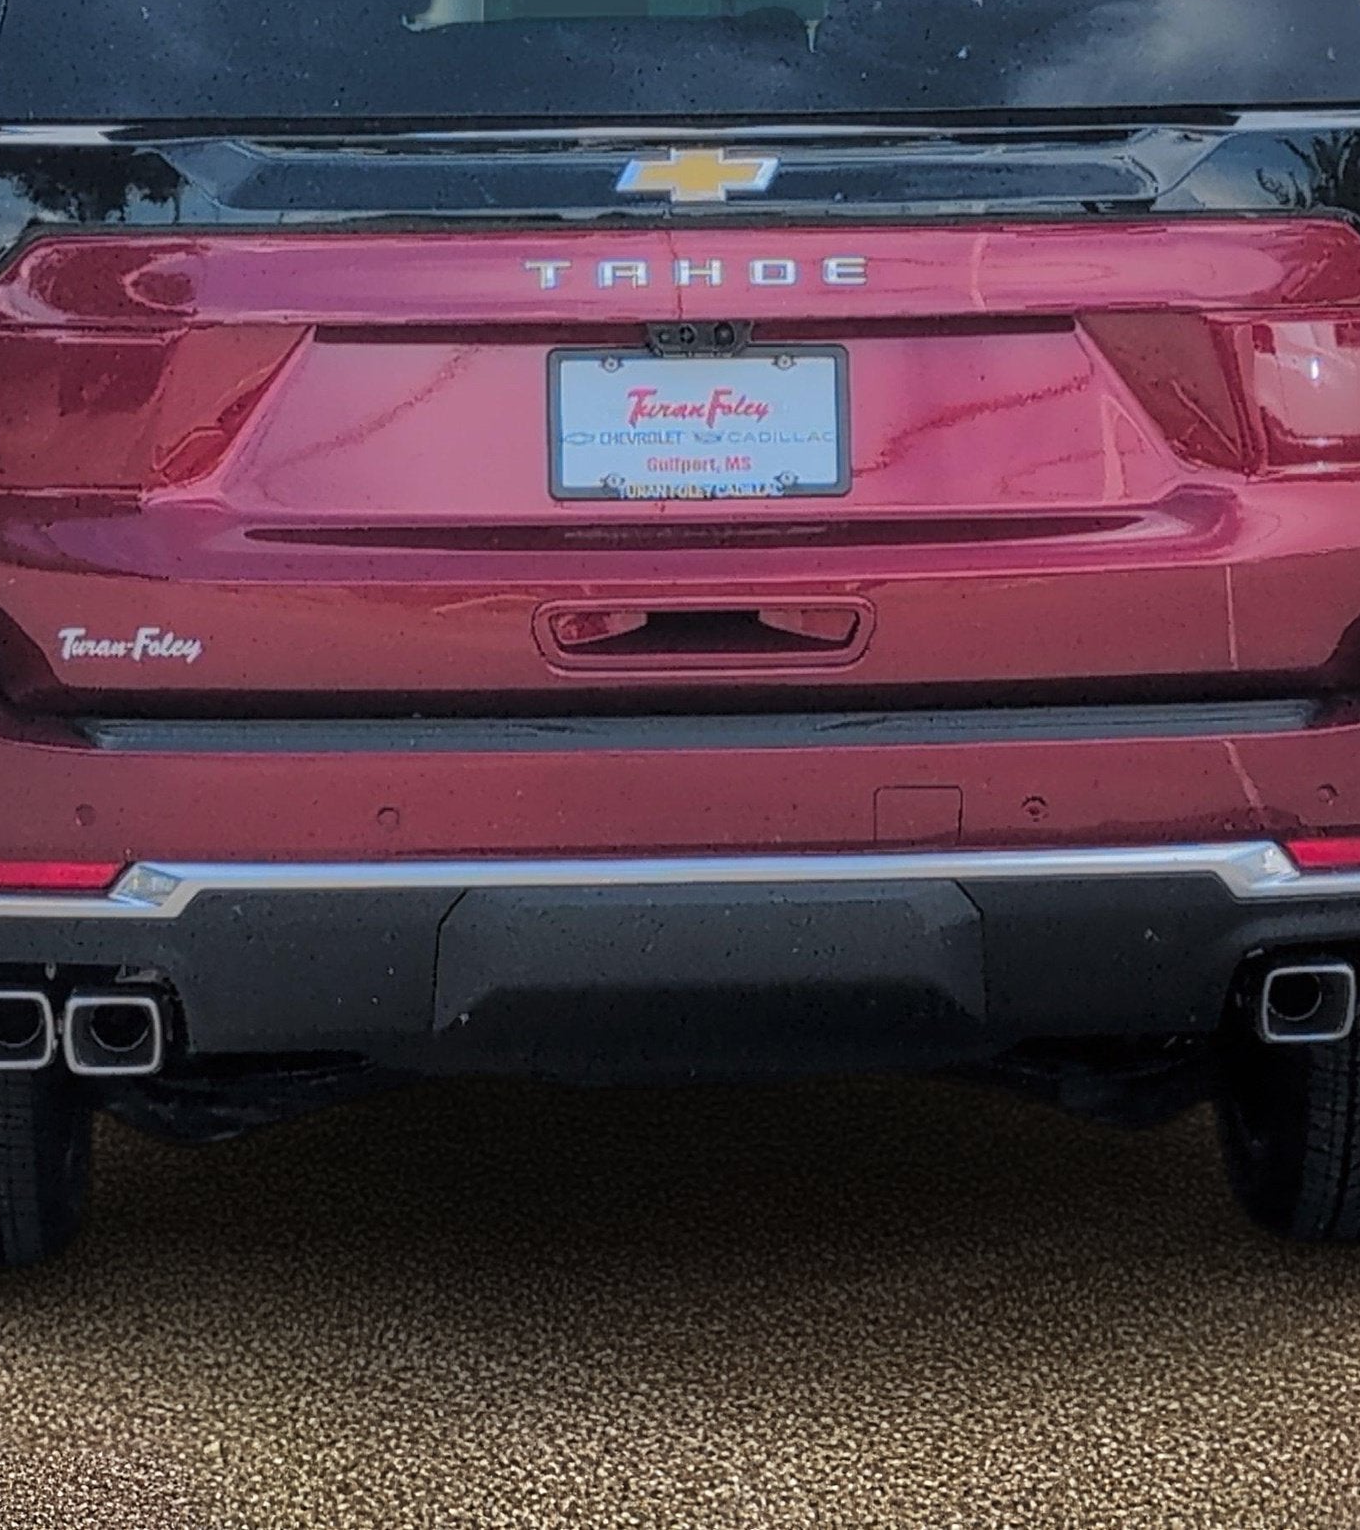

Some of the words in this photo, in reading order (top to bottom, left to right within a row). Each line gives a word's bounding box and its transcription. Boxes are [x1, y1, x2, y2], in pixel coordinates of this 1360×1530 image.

[524, 257, 868, 289] TAHOE
[599, 429, 682, 446] CHEVROLET
[727, 430, 835, 444] CADILLAC
[725, 455, 752, 472] MS
